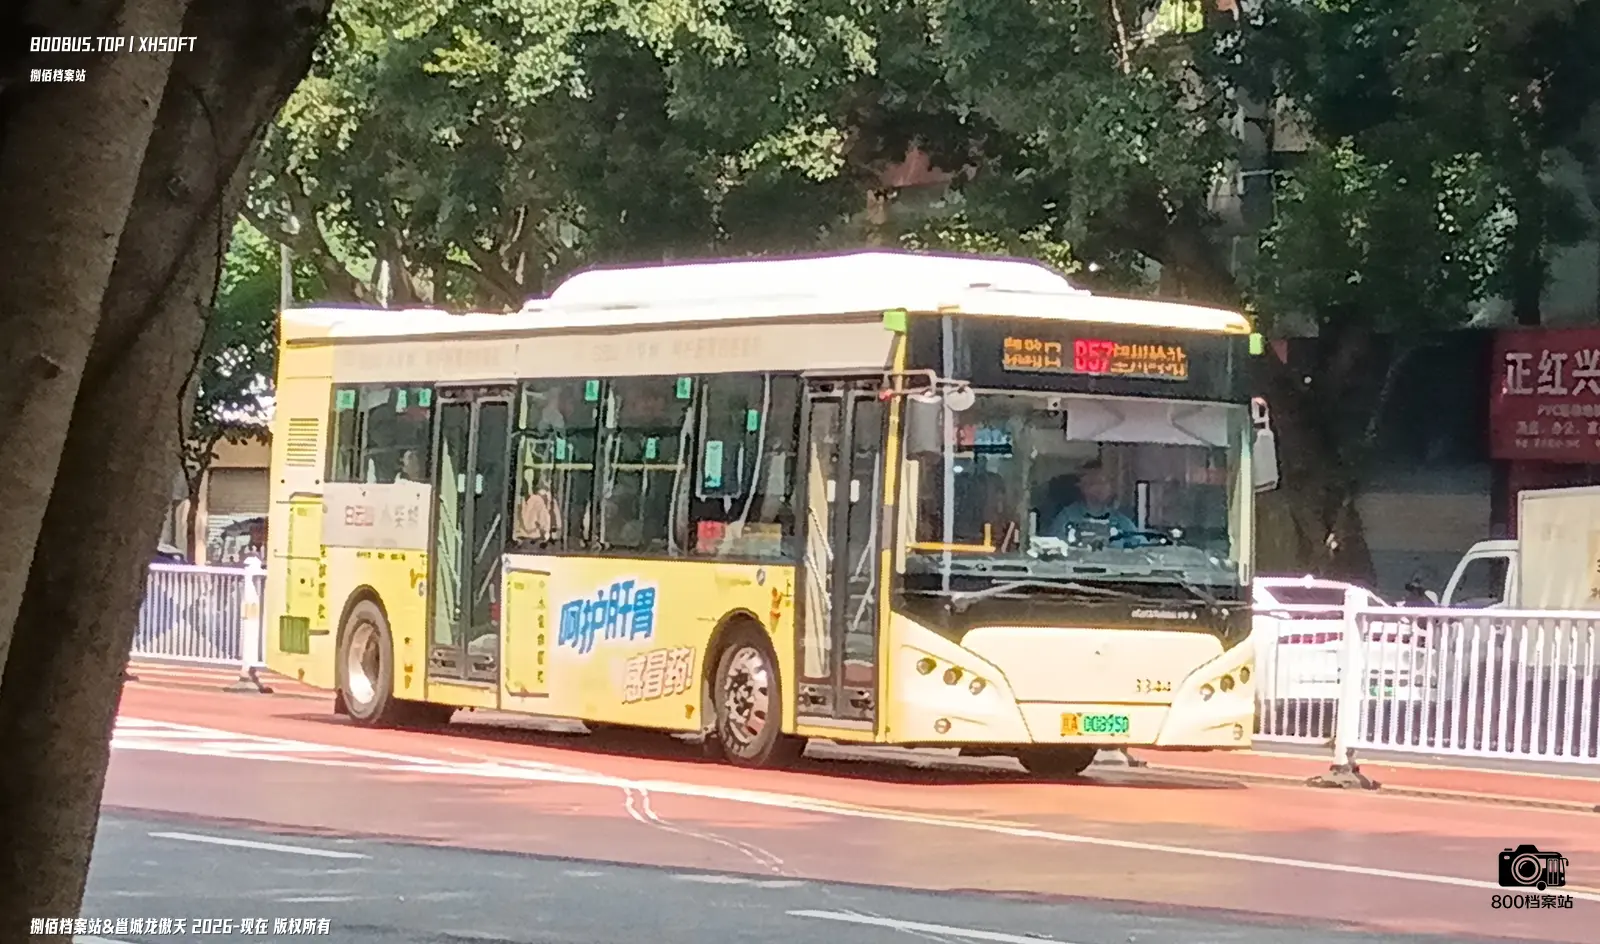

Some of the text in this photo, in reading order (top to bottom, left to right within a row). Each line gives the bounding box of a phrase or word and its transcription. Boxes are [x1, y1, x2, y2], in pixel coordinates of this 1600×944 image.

[1505, 349, 1600, 397] 正红兴
[557, 579, 656, 655] 呵护肝胃
